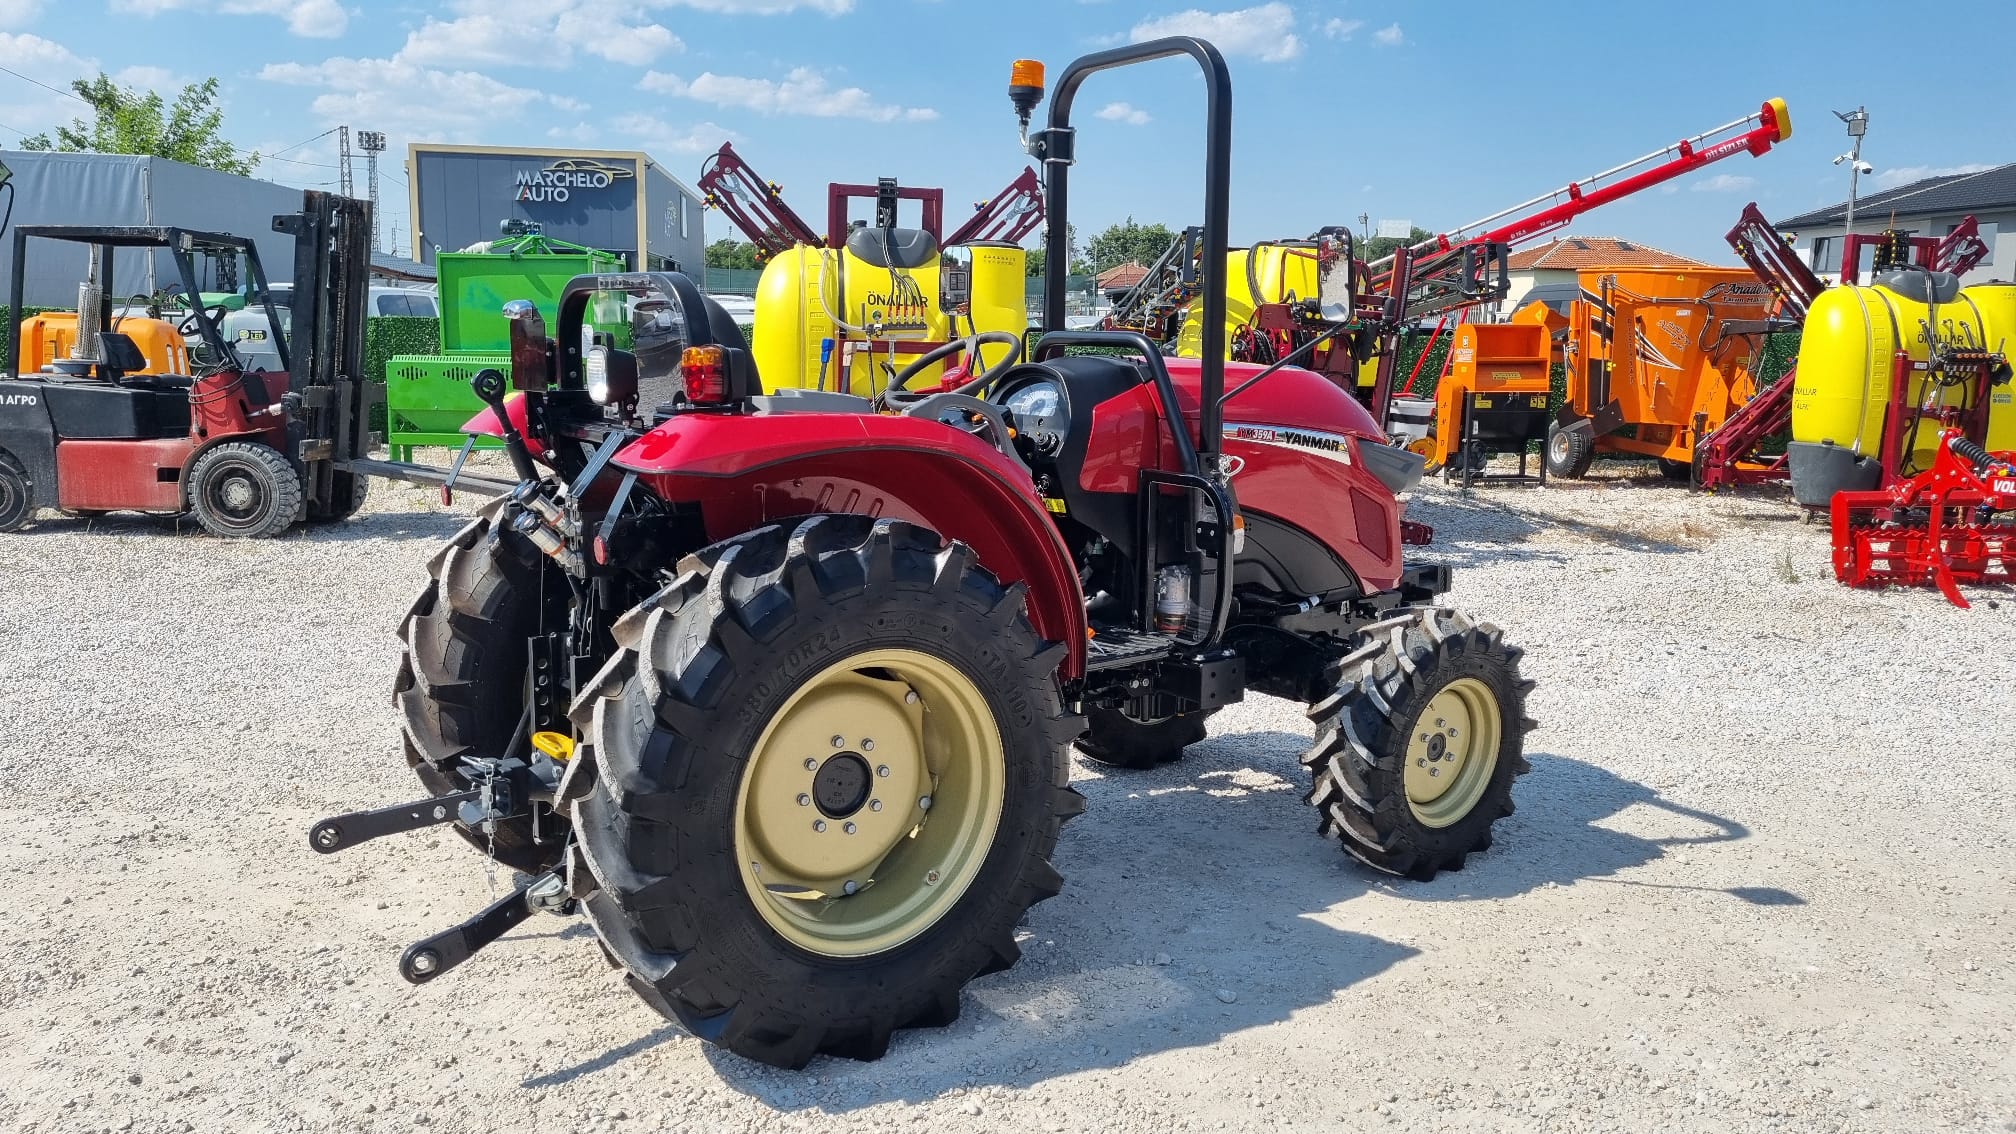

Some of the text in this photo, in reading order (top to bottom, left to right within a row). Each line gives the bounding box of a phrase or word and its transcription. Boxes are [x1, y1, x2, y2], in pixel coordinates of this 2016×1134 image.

[516, 169, 609, 189] MARCHELO
[515, 185, 570, 203] AUTO
[867, 290, 929, 308] ÖNALLAR
[6, 394, 37, 406] АГРО
[1284, 431, 1340, 452] YANMAR
